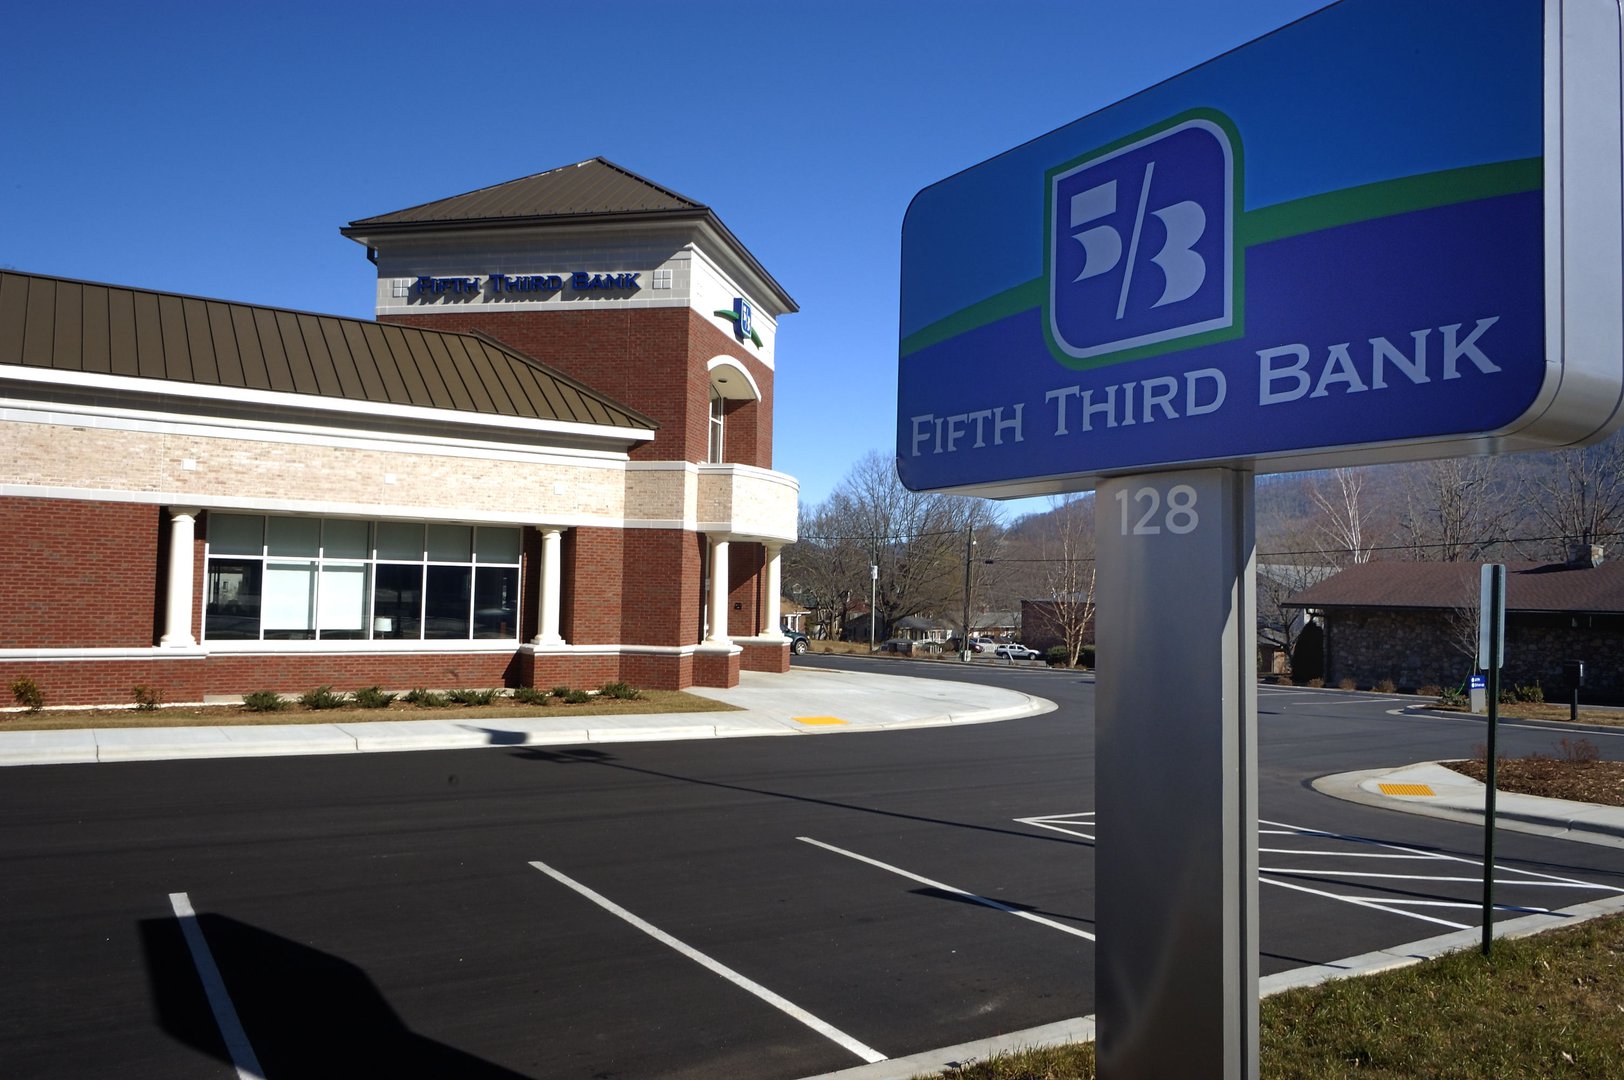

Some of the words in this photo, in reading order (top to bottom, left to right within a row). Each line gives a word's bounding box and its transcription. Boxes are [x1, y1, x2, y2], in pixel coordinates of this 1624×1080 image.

[417, 276, 481, 294] FIFTH
[488, 274, 563, 292] THIRD
[571, 271, 641, 290] BANK
[911, 404, 1024, 457] FIFTH
[1045, 369, 1227, 437] THIRD
[1256, 316, 1501, 406] BANK
[1116, 485, 1199, 536] 128
